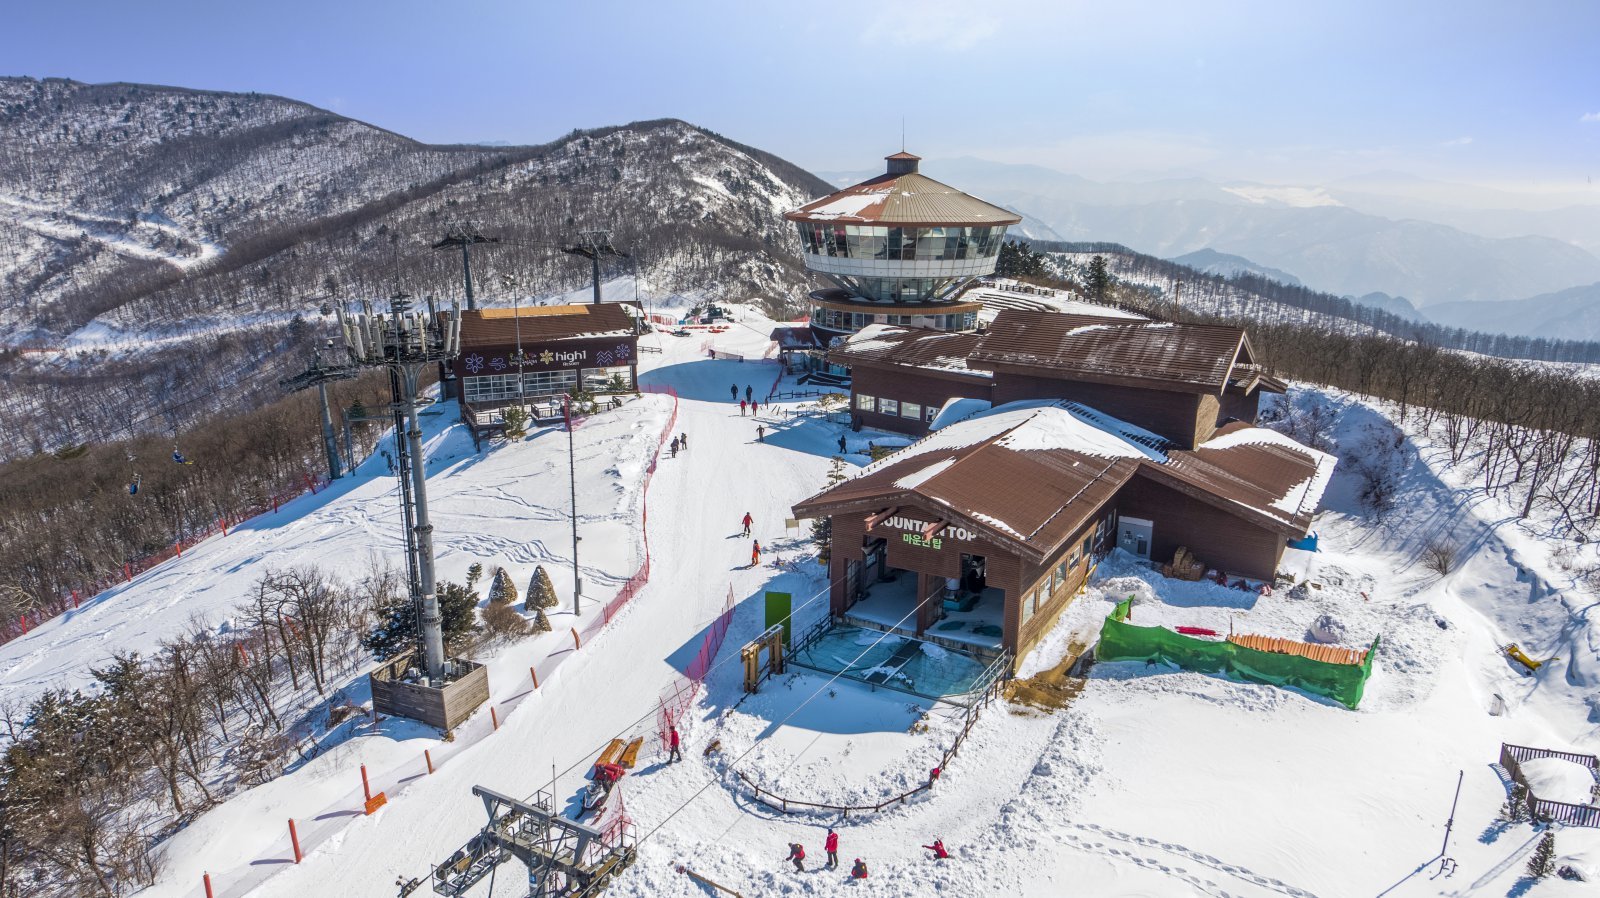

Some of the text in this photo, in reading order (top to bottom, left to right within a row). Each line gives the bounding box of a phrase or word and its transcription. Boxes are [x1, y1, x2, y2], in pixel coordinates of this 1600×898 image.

[555, 350, 586, 363] high1
[880, 516, 977, 541] OUNTA TOP
